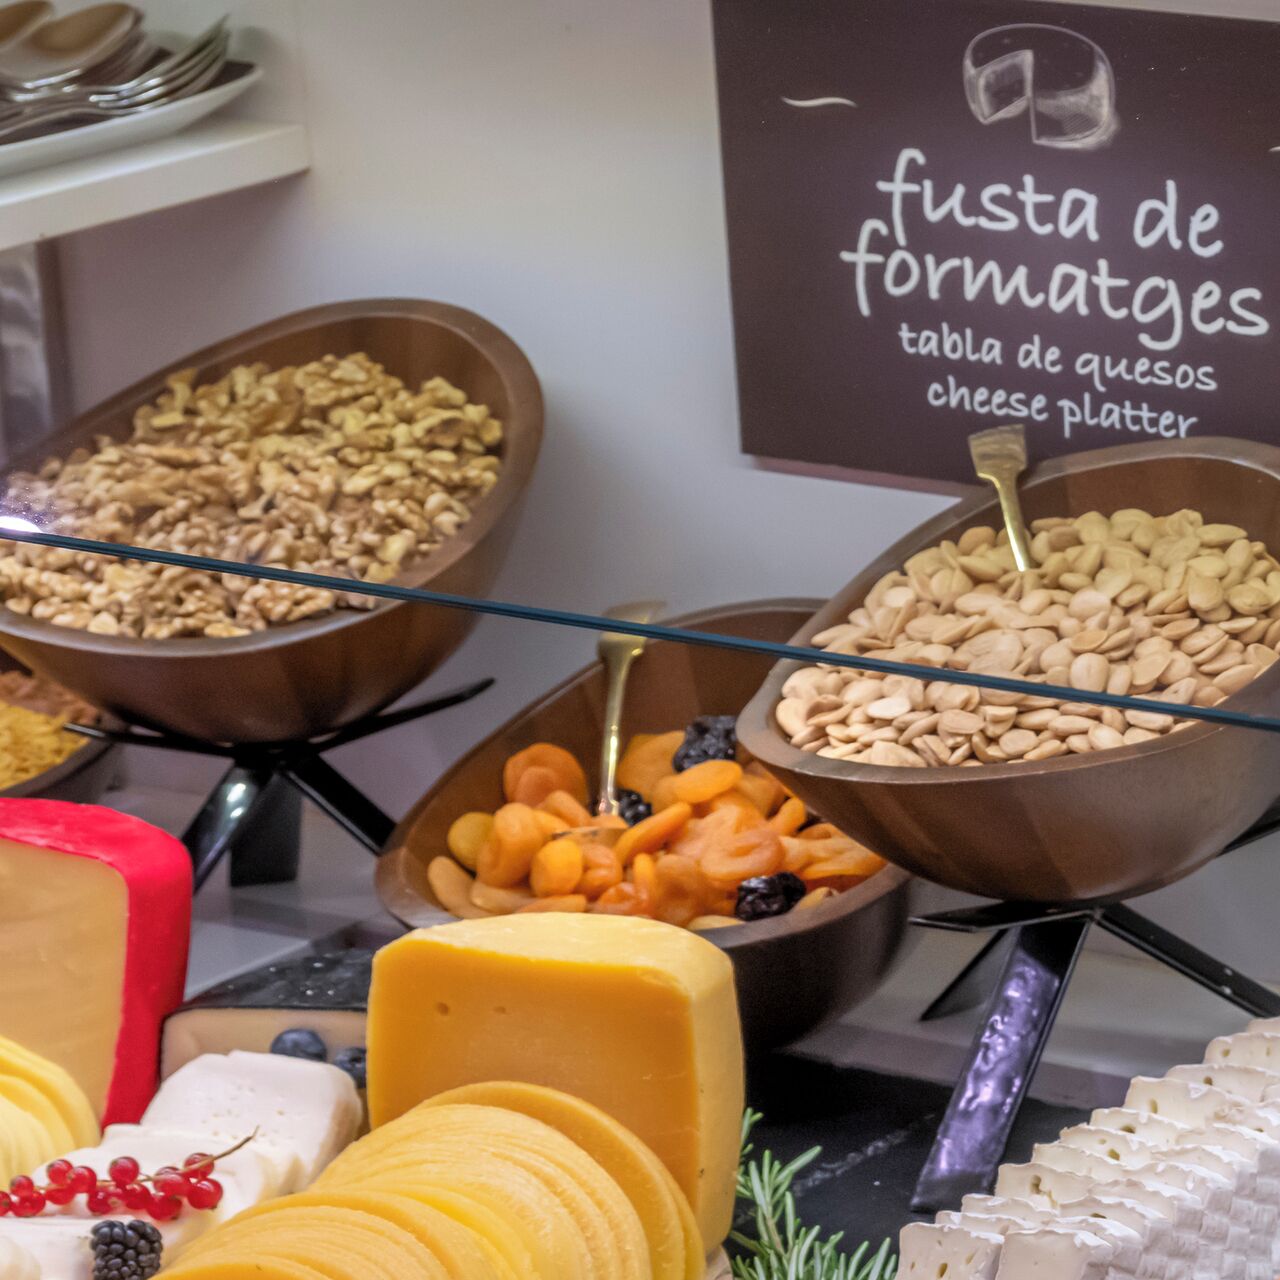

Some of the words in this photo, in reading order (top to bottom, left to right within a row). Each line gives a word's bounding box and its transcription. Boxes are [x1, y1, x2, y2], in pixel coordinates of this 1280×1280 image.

[876, 148, 1100, 246] fusta
[1133, 179, 1224, 258] de
[840, 218, 1270, 349] formatges
[898, 321, 1003, 365] tabla
[1017, 334, 1063, 374] de
[1074, 352, 1218, 393] quesos
[927, 378, 1049, 422] cheese
[1056, 391, 1198, 440] platter
